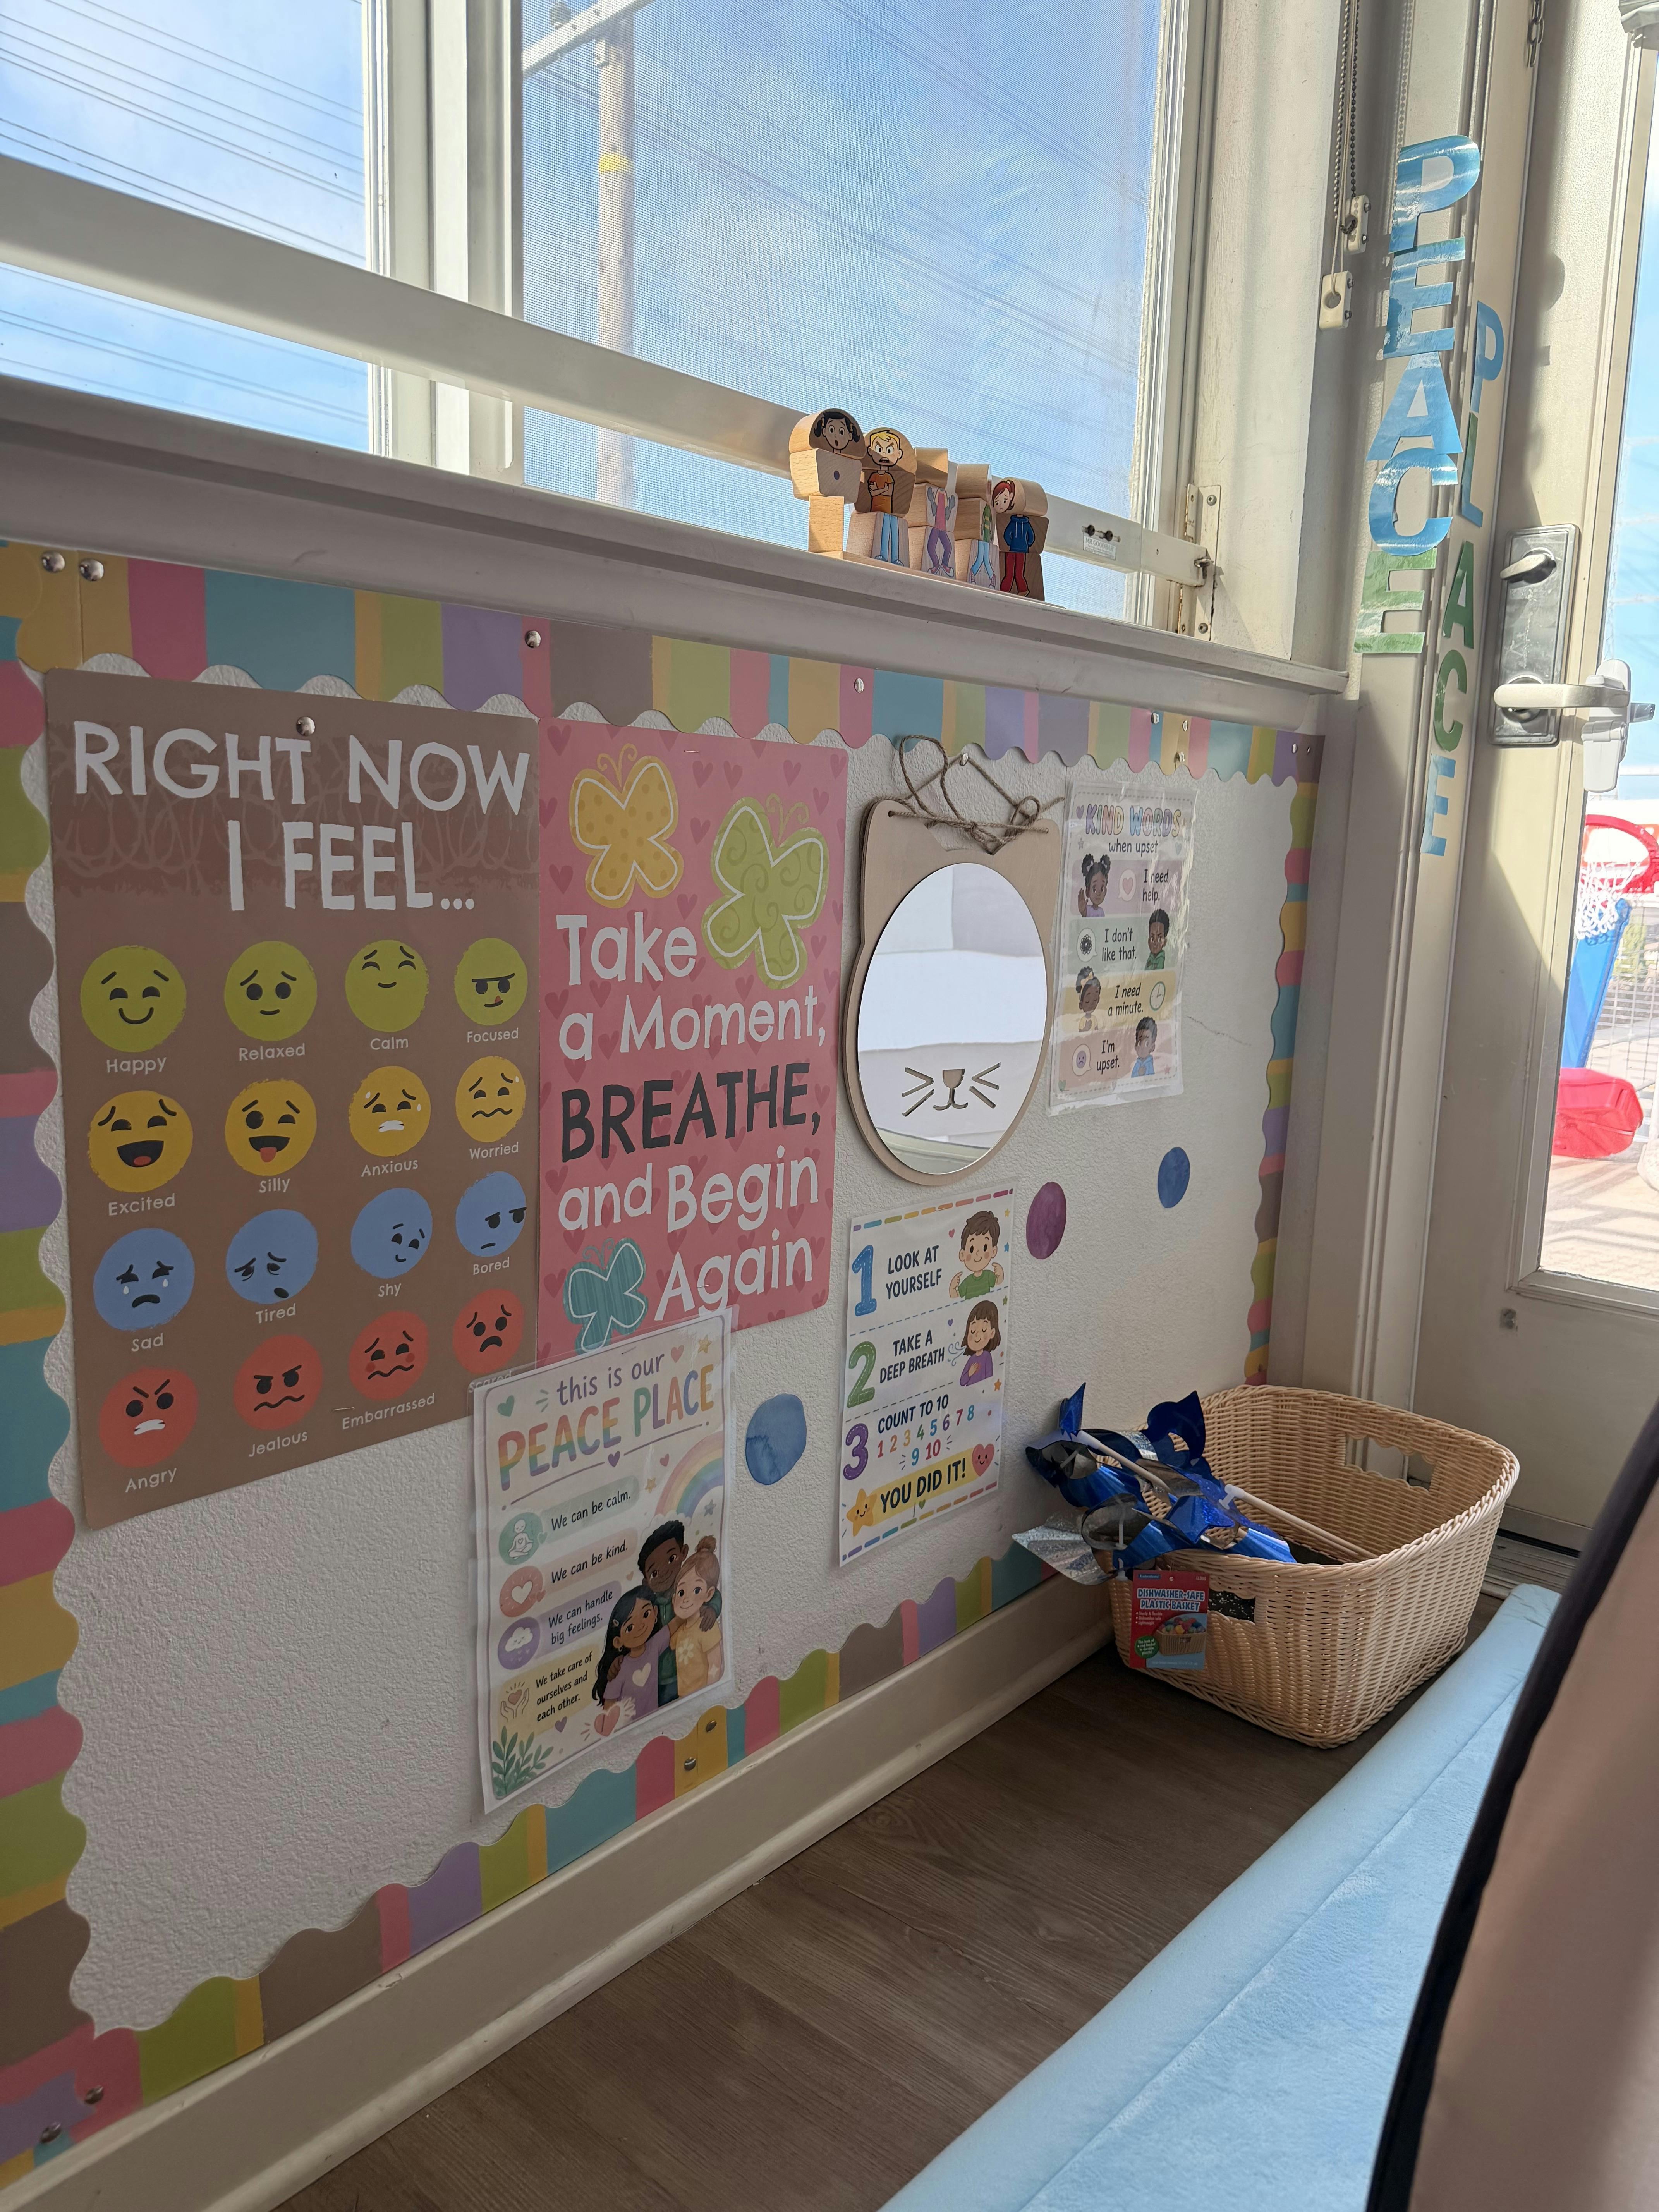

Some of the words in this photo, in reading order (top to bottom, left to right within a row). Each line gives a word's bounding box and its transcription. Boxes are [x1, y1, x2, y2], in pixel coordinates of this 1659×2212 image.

[1353, 135, 1480, 654] PEACE
[1420, 300, 1504, 857] PLACE
[74, 721, 311, 804] RIGHT
[349, 735, 530, 814] NOW
[1085, 804, 1124, 835] KIND
[1130, 805, 1181, 837] WORDS
[1109, 838, 1132, 852] when
[1136, 840, 1158, 857] upset
[228, 820, 244, 911] I
[283, 821, 474, 910] FEEL...
[1144, 869, 1148, 883] I
[1150, 869, 1169, 883] need
[1142, 887, 1160, 905] help.
[556, 912, 697, 986] Take
[1105, 929, 1109, 943] I
[1112, 928, 1133, 942] don't
[1102, 947, 1115, 962] like
[1119, 947, 1137, 960] that.
[1115, 985, 1120, 999] I
[1121, 982, 1141, 997] need
[559, 1013, 593, 1061] a
[620, 985, 825, 1053] Moment,
[1108, 1006, 1113, 1016] a
[1115, 1003, 1143, 1016] minute.
[371, 1037, 409, 1050] Calm
[467, 1028, 519, 1042] Focused
[1101, 1040, 1115, 1054] I'm
[106, 1057, 167, 1075] Happy
[239, 1043, 305, 1061] Relaxed
[1097, 1057, 1120, 1075] upset.
[562, 1063, 821, 1163] BREATHE,
[469, 1142, 519, 1159] Worried
[361, 1160, 418, 1177] Anxious
[259, 1178, 290, 1193] Silly
[558, 1163, 652, 1230] and
[668, 1145, 818, 1233] Begin
[108, 1194, 175, 1216] Excited
[473, 1257, 510, 1275] Bored
[888, 1250, 920, 1274] LOOK
[924, 1245, 939, 1265] AT
[654, 1228, 812, 1321] Again
[852, 1245, 877, 1316] 1
[886, 1268, 942, 1299] YOURSELF
[378, 1283, 401, 1297] Shy
[256, 1304, 296, 1324] Tired
[131, 1333, 164, 1352] Sad
[893, 1333, 921, 1356] TAKE
[925, 1330, 933, 1345] A
[556, 1376, 598, 1405] this
[608, 1366, 622, 1389] is
[631, 1353, 665, 1379] our
[847, 1341, 876, 1408] 2
[880, 1360, 905, 1383] DEEP
[908, 1347, 945, 1373] BREATH
[342, 1393, 435, 1429] Embarrassed
[878, 1406, 916, 1434] COUNT
[920, 1400, 933, 1418] TO
[937, 1394, 948, 1412] 10
[498, 1397, 622, 1491] PEACE
[634, 1364, 714, 1437] PLACE
[878, 1440, 883, 1458] 1
[890, 1435, 897, 1452] 2
[904, 1429, 911, 1446] 3
[917, 1424, 924, 1441] 4
[930, 1419, 937, 1436] 5
[943, 1414, 950, 1431] 6
[957, 1409, 963, 1426] 7
[967, 1405, 974, 1421] 8
[249, 1432, 308, 1457] Jealous
[843, 1423, 869, 1480] 3
[912, 1448, 919, 1466] 9
[926, 1439, 941, 1460] 10
[125, 1468, 177, 1492] Angry
[880, 1481, 912, 1513] YOU
[917, 1470, 942, 1497] DID
[947, 1458, 965, 1484] IT!
[551, 1515, 567, 1530] We
[572, 1509, 588, 1523] can
[592, 1501, 603, 1514] be
[607, 1491, 630, 1508] calm.
[551, 1568, 567, 1583] We
[571, 1561, 587, 1575] can
[592, 1553, 602, 1566] be
[606, 1539, 627, 1559] kind.
[549, 1613, 563, 1628] We
[567, 1606, 582, 1620] can
[585, 1590, 612, 1611] handle
[1138, 1589, 1204, 1601] DISHWASHER-SAFE
[1140, 1599, 1170, 1609] PLASTIC
[1171, 1601, 1200, 1612] BASKET
[552, 1631, 564, 1645] big
[568, 1613, 603, 1636] feelings.
[536, 1676, 547, 1688] We
[550, 1668, 565, 1681] take
[568, 1659, 582, 1673] care
[585, 1651, 592, 1663] of
[537, 1681, 572, 1705] ourselves
[574, 1671, 587, 1686] and
[537, 1705, 555, 1721] each
[558, 1693, 580, 1711] other.
